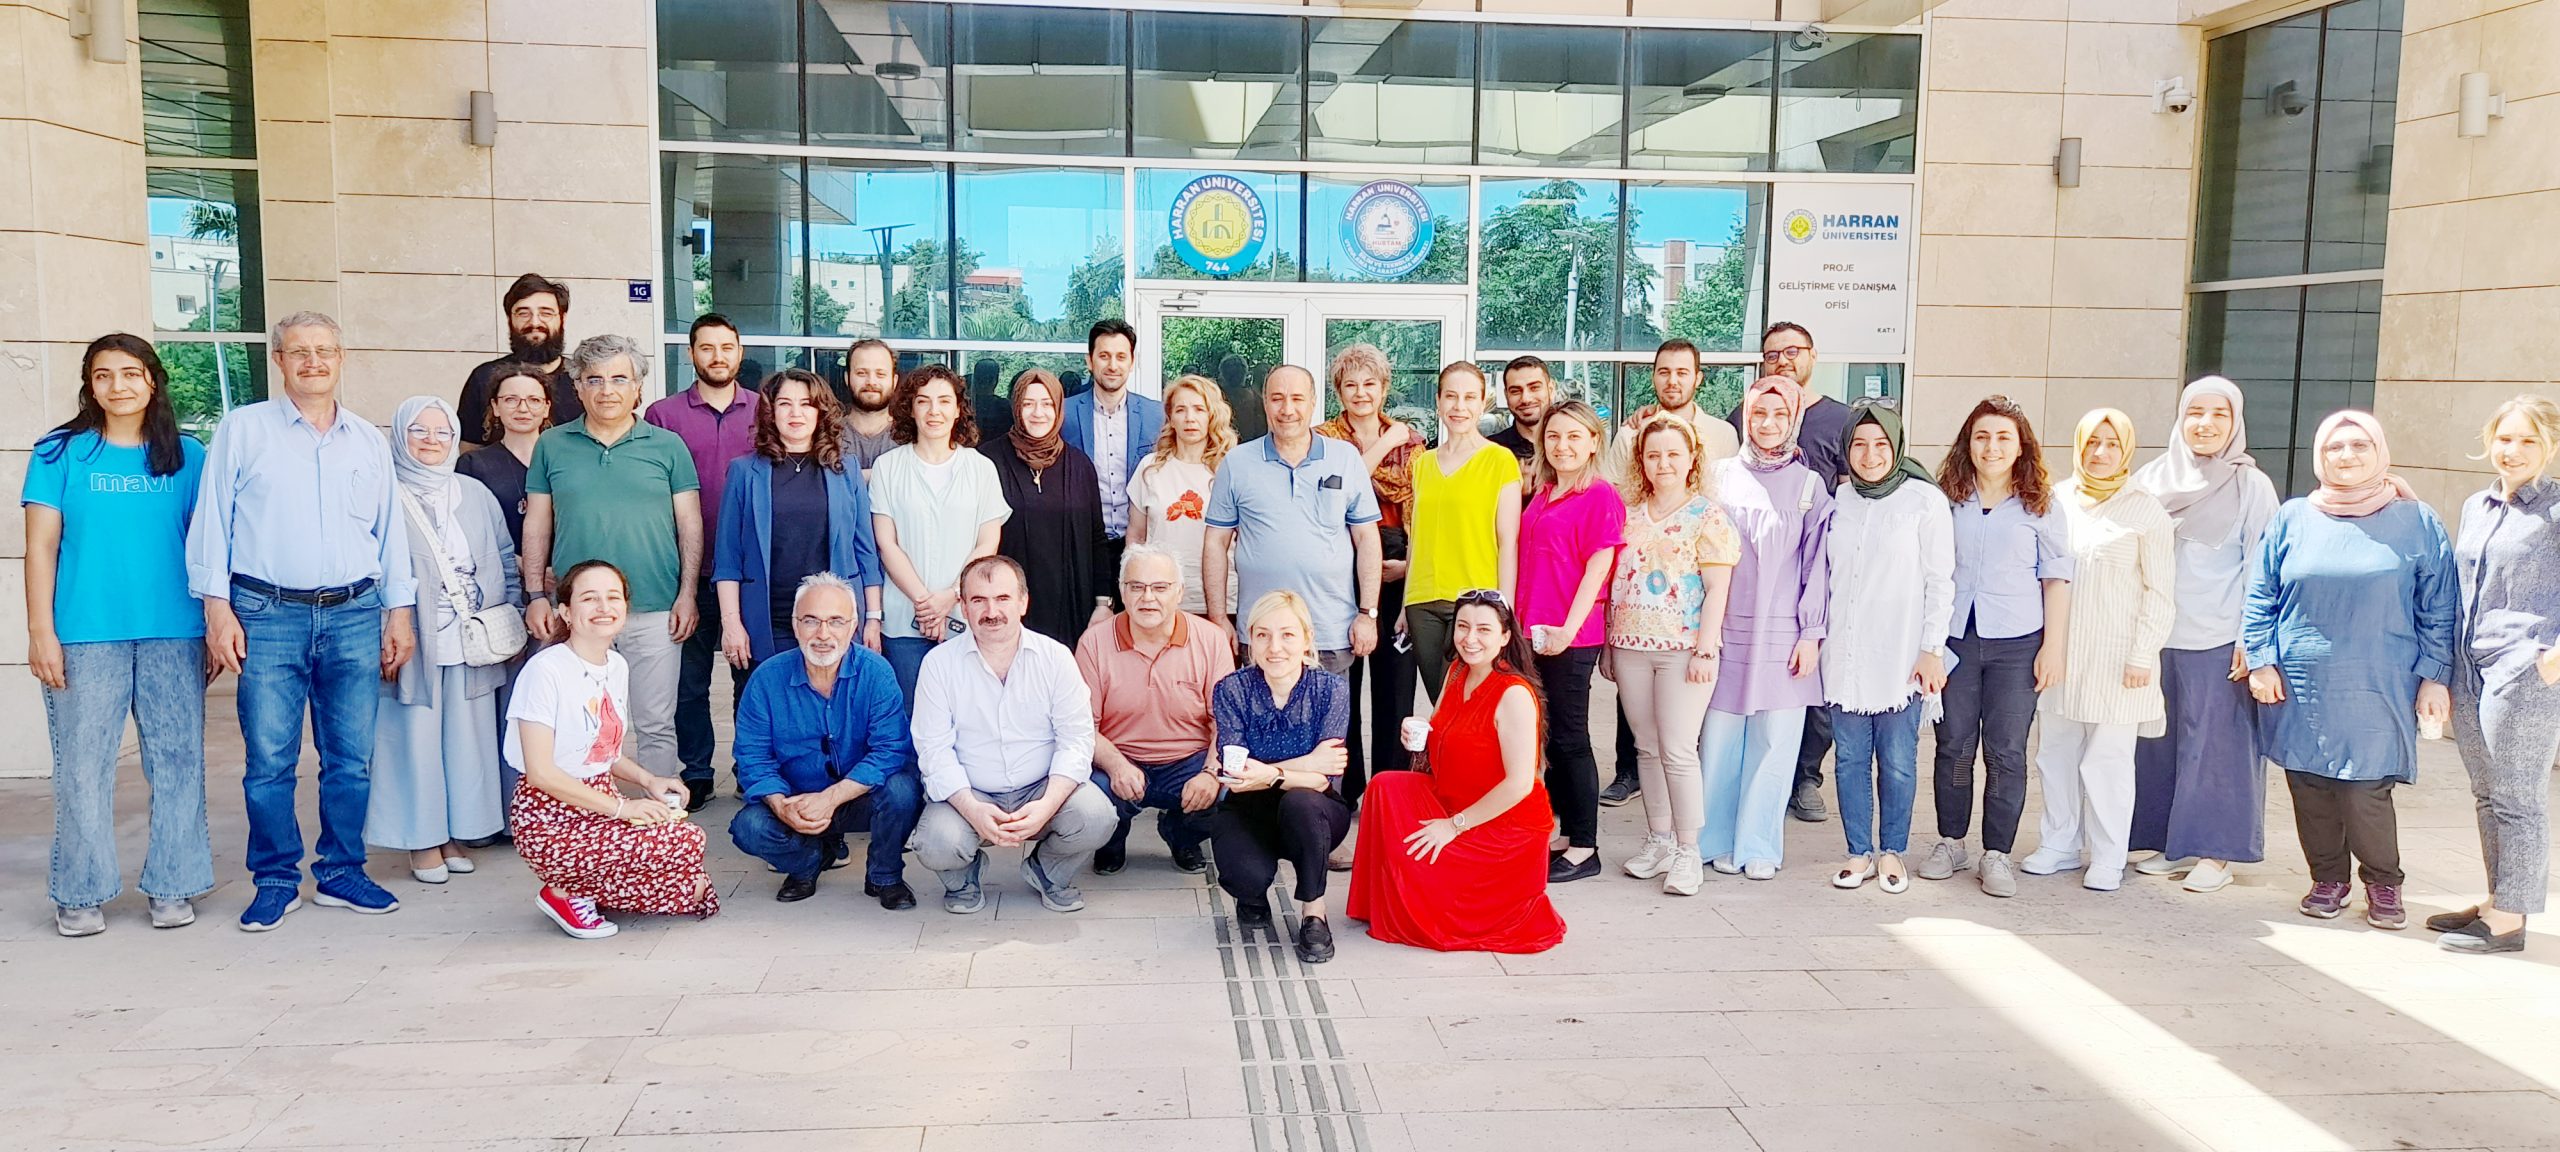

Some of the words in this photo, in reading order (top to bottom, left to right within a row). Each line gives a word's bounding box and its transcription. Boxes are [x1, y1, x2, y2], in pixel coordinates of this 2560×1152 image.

[1344, 187, 1376, 221] HARRAN
[1171, 182, 1201, 240] HARRAN
[1822, 214, 1899, 228] HARRAN
[1822, 230, 1898, 241] ÜNİVERSİTESİ
[1205, 260, 1230, 272] 744
[1822, 263, 1855, 272] PROJE
[633, 286, 647, 296] 1G
[1778, 280, 1835, 293] GELİŞTİRME
[1837, 282, 1850, 291] VE
[1852, 282, 1897, 293] DANIŞMA
[1825, 300, 1850, 310] OFİSİ
[90, 472, 174, 493] mavi
